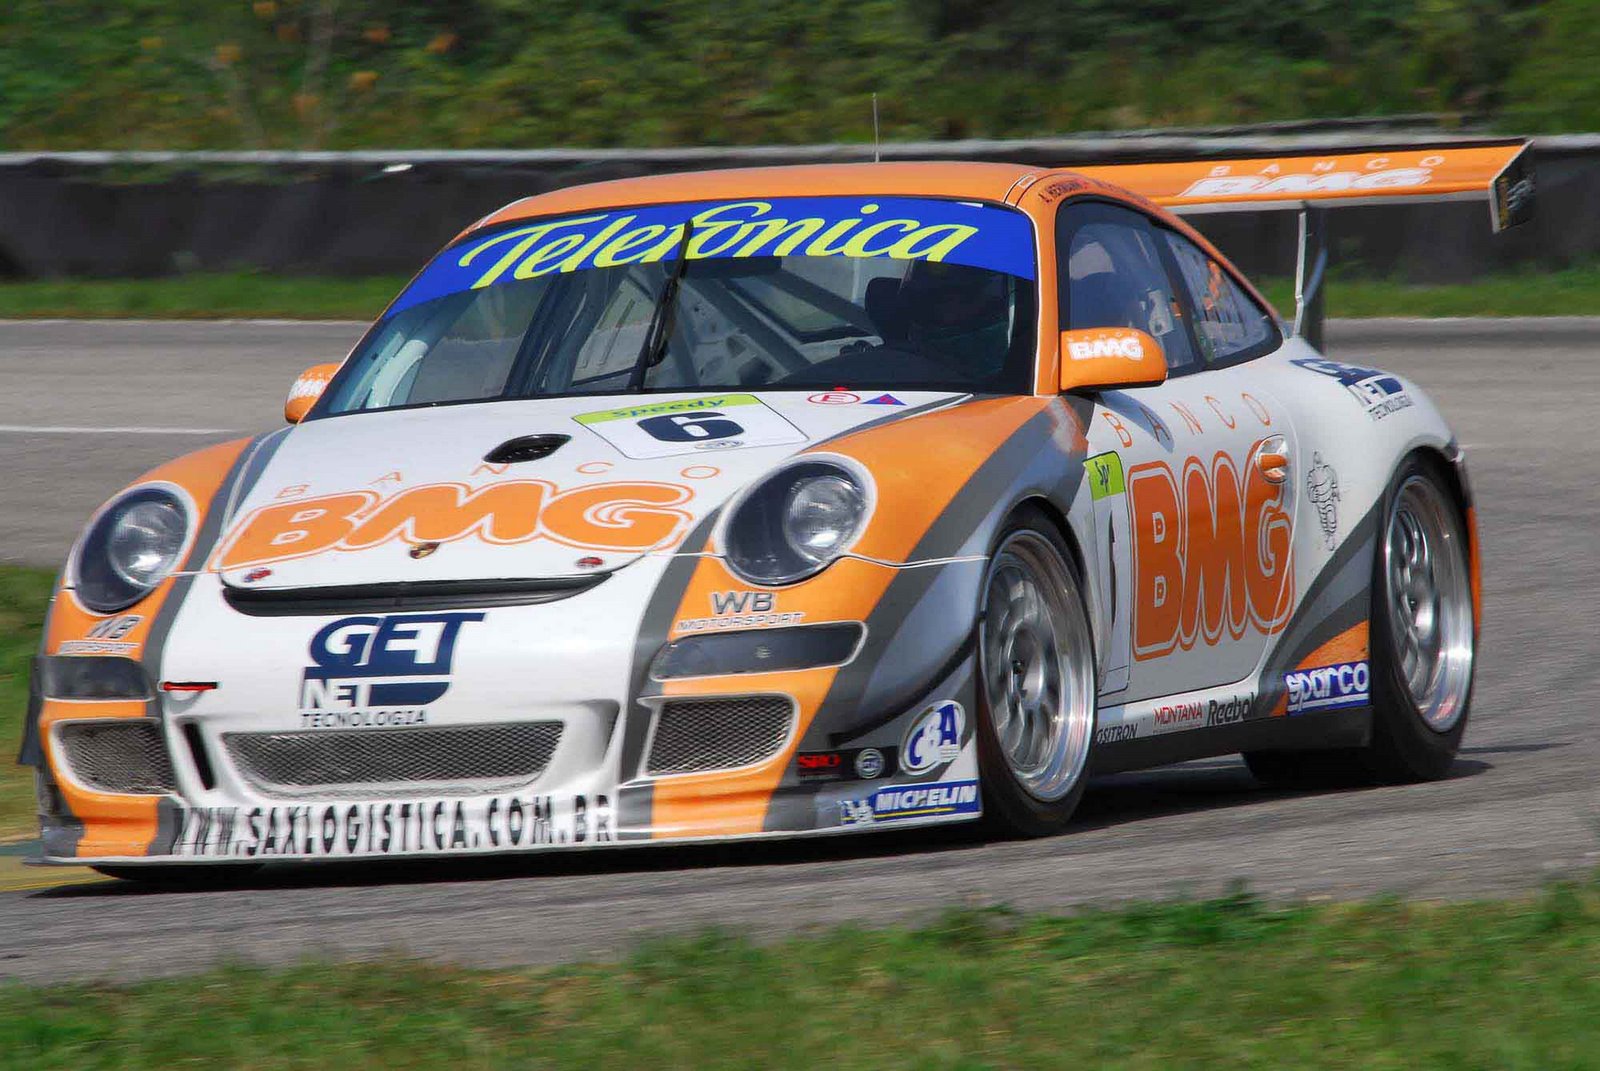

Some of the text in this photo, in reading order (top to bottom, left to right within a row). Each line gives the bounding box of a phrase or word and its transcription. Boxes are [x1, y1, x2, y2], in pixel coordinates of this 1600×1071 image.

[1177, 168, 1434, 197] BMG
[1068, 337, 1145, 361] BMG
[612, 399, 725, 418] speedy
[636, 411, 745, 442] 6
[208, 478, 695, 573] BMG
[1127, 438, 1297, 662] BMG
[711, 591, 775, 615] WB
[676, 611, 804, 632] MOTORSPORT
[310, 612, 486, 668] GET
[301, 678, 372, 709] NET
[1285, 661, 1369, 712] sparco
[301, 710, 428, 728] TECNOLOGIA
[1153, 702, 1204, 726] MONTANA
[1096, 723, 1139, 744] OSITRON
[875, 785, 977, 812] MICHELIN
